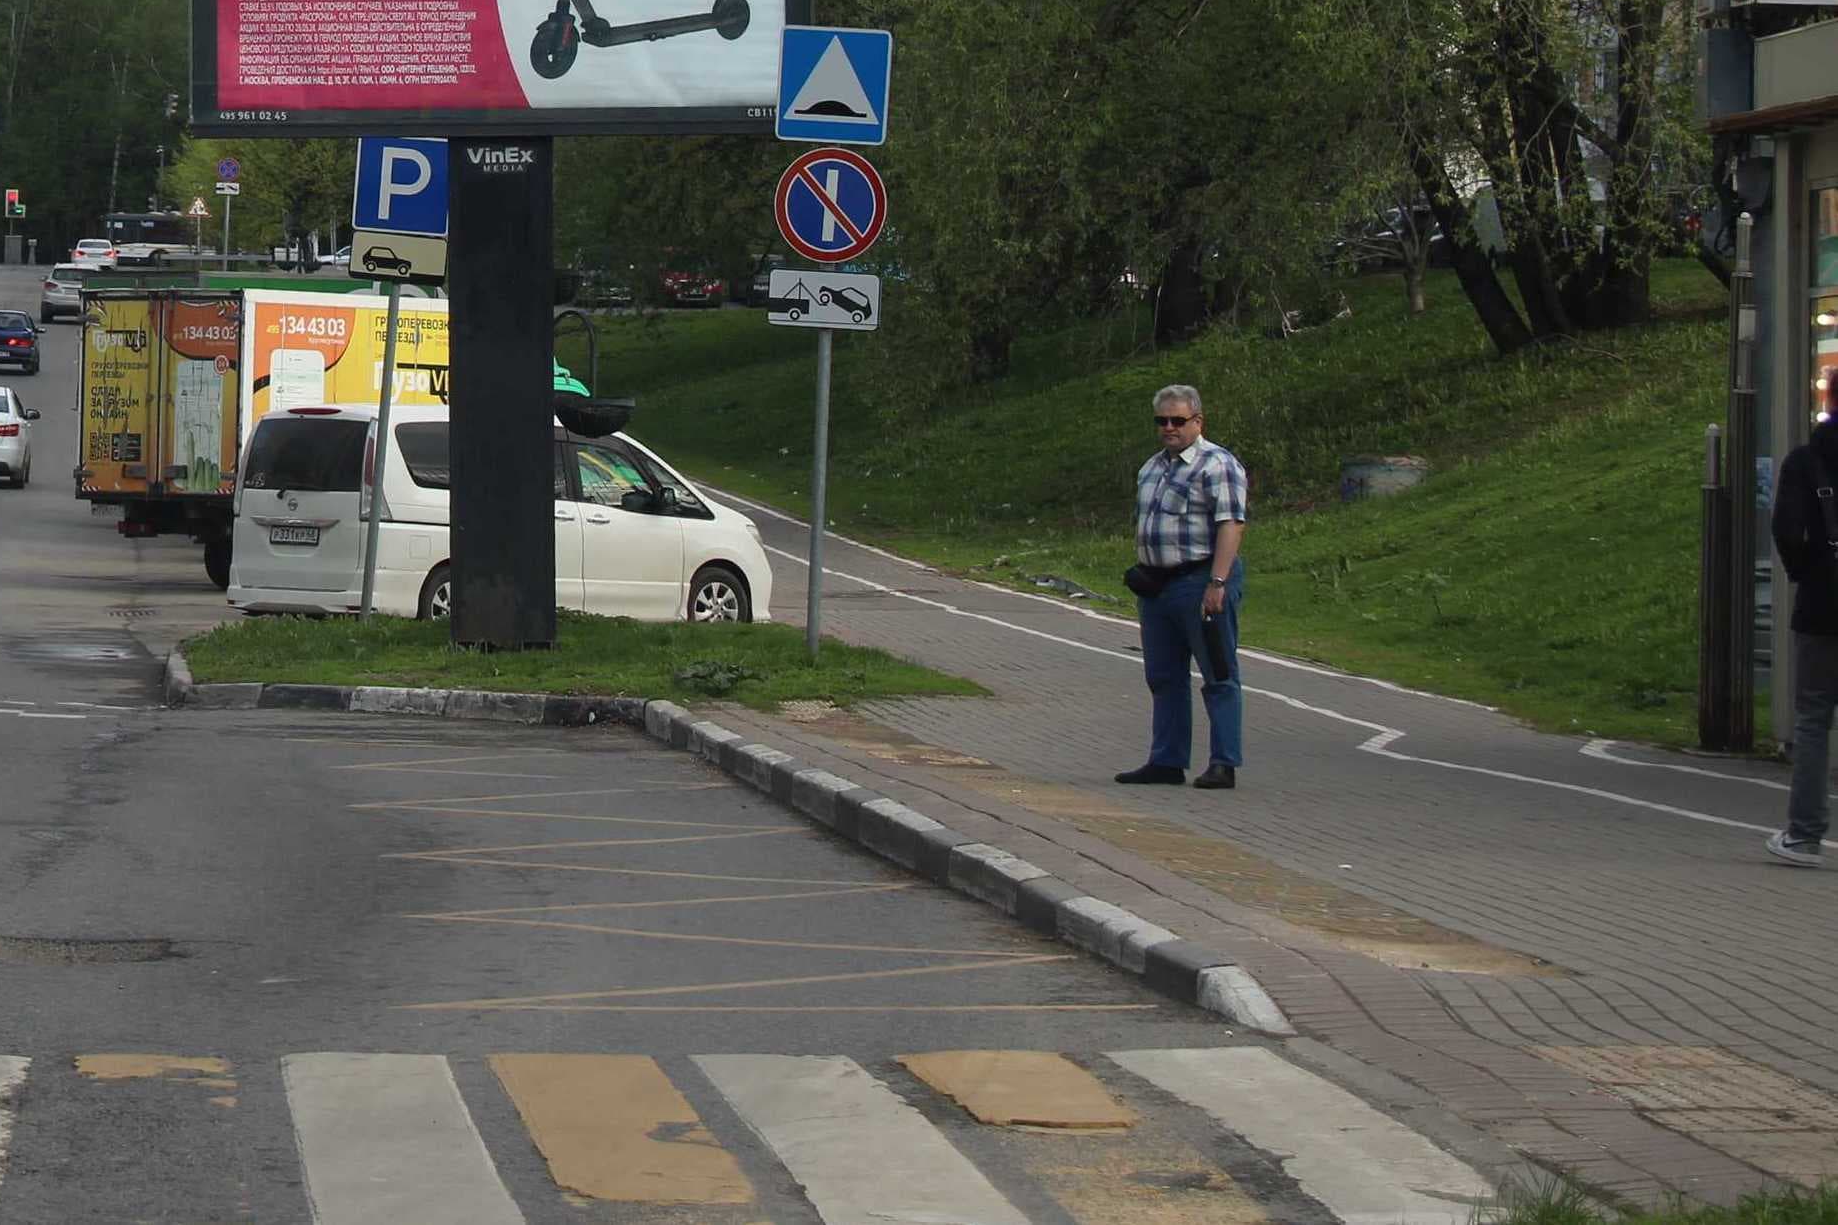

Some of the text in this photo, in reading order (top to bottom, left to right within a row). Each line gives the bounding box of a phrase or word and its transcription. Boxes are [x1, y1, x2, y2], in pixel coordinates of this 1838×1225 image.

[237, 111, 255, 120] 961
[259, 111, 272, 120] 02
[274, 111, 287, 121] 45
[467, 147, 533, 163] VinEx
[378, 147, 432, 220] P
[280, 315, 306, 335] 134
[307, 317, 325, 336] 43
[327, 318, 346, 337] 03
